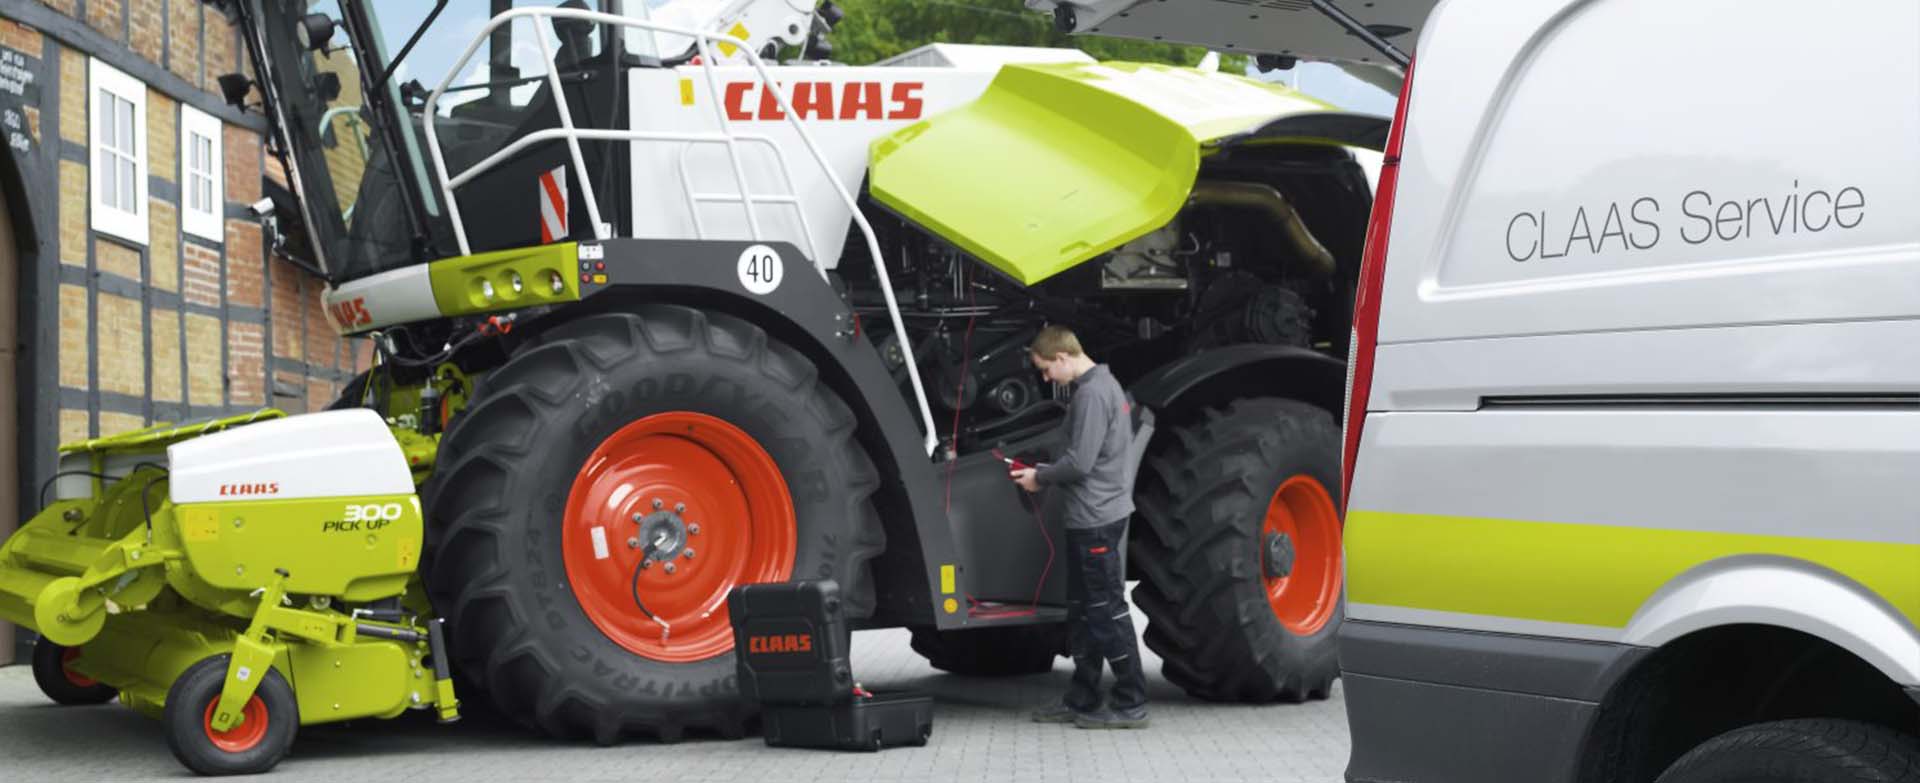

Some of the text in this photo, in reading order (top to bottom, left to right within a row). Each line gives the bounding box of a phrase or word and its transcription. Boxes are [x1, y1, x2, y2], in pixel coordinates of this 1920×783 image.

[724, 82, 924, 121] CLAAS
[1506, 180, 1865, 262] CLAAS Service
[747, 254, 774, 283] 40
[219, 483, 279, 496] CLAAS
[344, 503, 402, 521] 300
[322, 520, 390, 532] PICK UP
[750, 634, 811, 653] CLAAS
